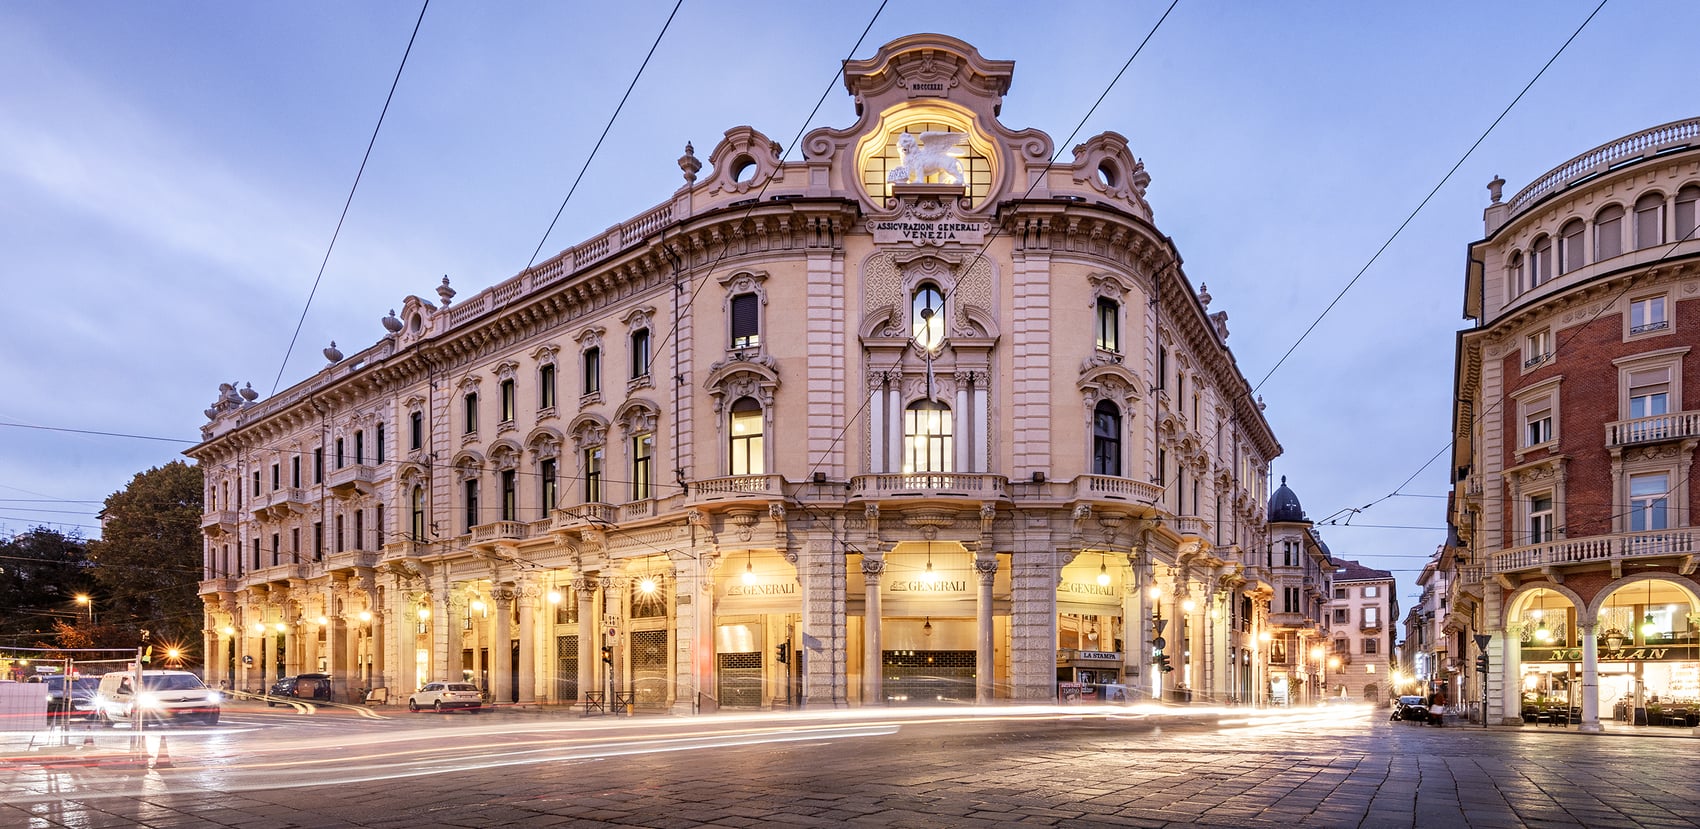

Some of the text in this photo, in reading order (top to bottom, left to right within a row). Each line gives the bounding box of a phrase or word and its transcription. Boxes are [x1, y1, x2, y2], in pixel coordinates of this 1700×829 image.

[877, 223, 934, 231] ASSICVRAZIONI
[903, 231, 956, 239] VENEZIA
[743, 583, 795, 595] GENERALI
[909, 581, 966, 592] GENERALI
[1071, 583, 1114, 596] GENERALI
